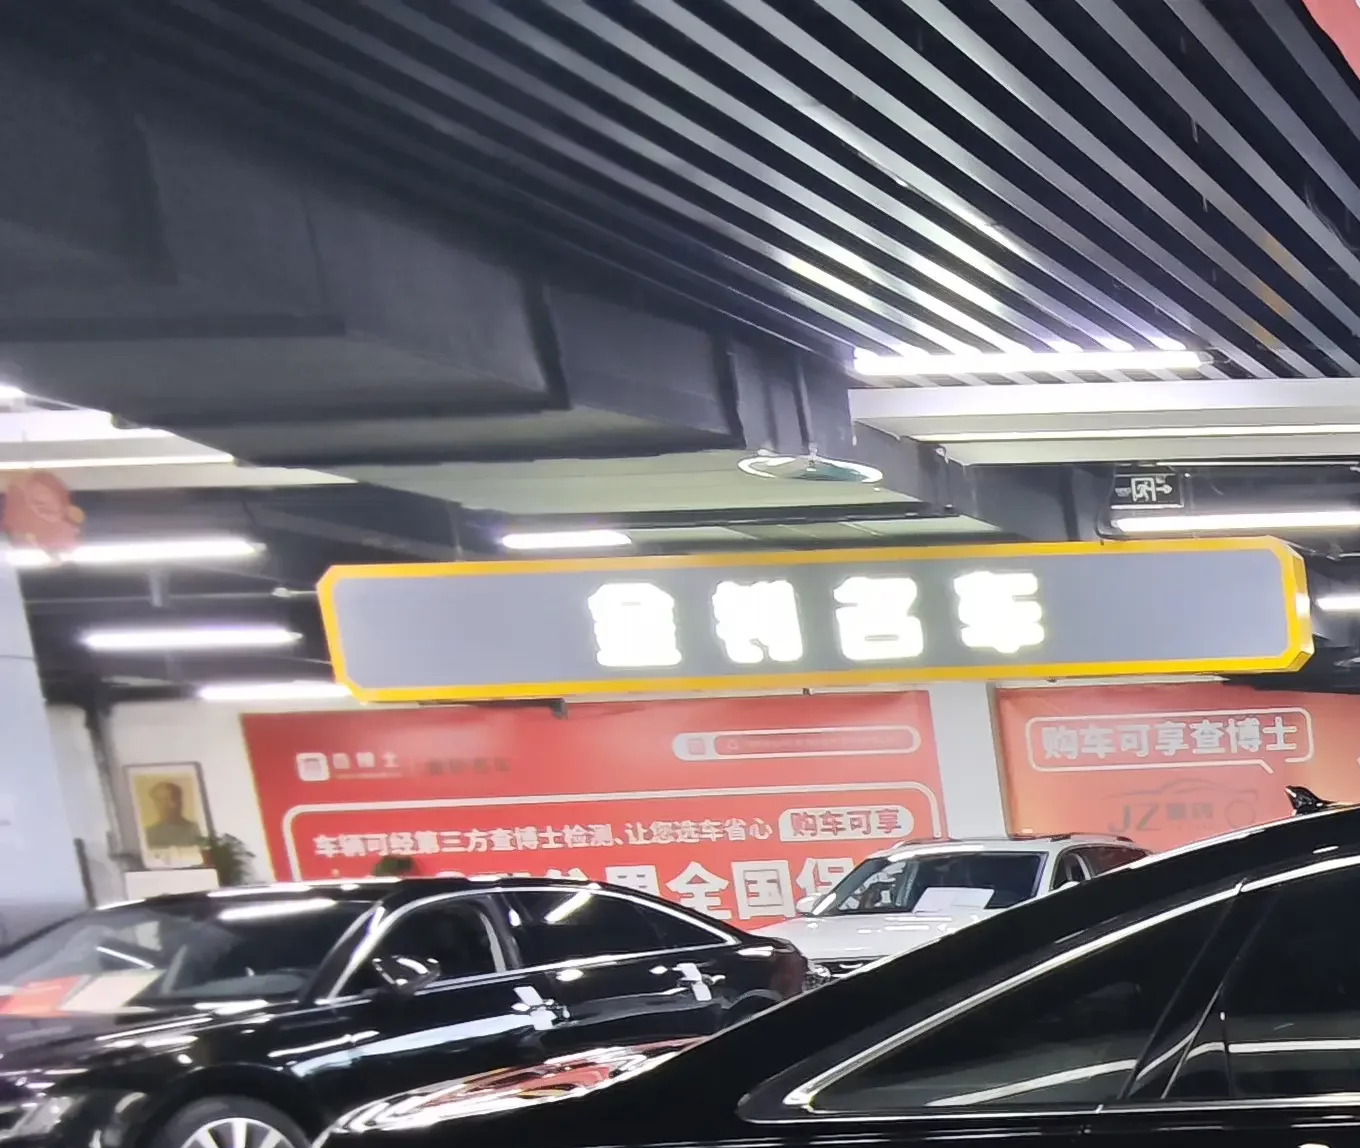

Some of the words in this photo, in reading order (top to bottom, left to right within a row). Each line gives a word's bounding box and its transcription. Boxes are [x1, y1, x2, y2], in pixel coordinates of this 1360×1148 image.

[1041, 715, 1298, 760] 购车可享查博士
[789, 808, 903, 837] 购车可享
